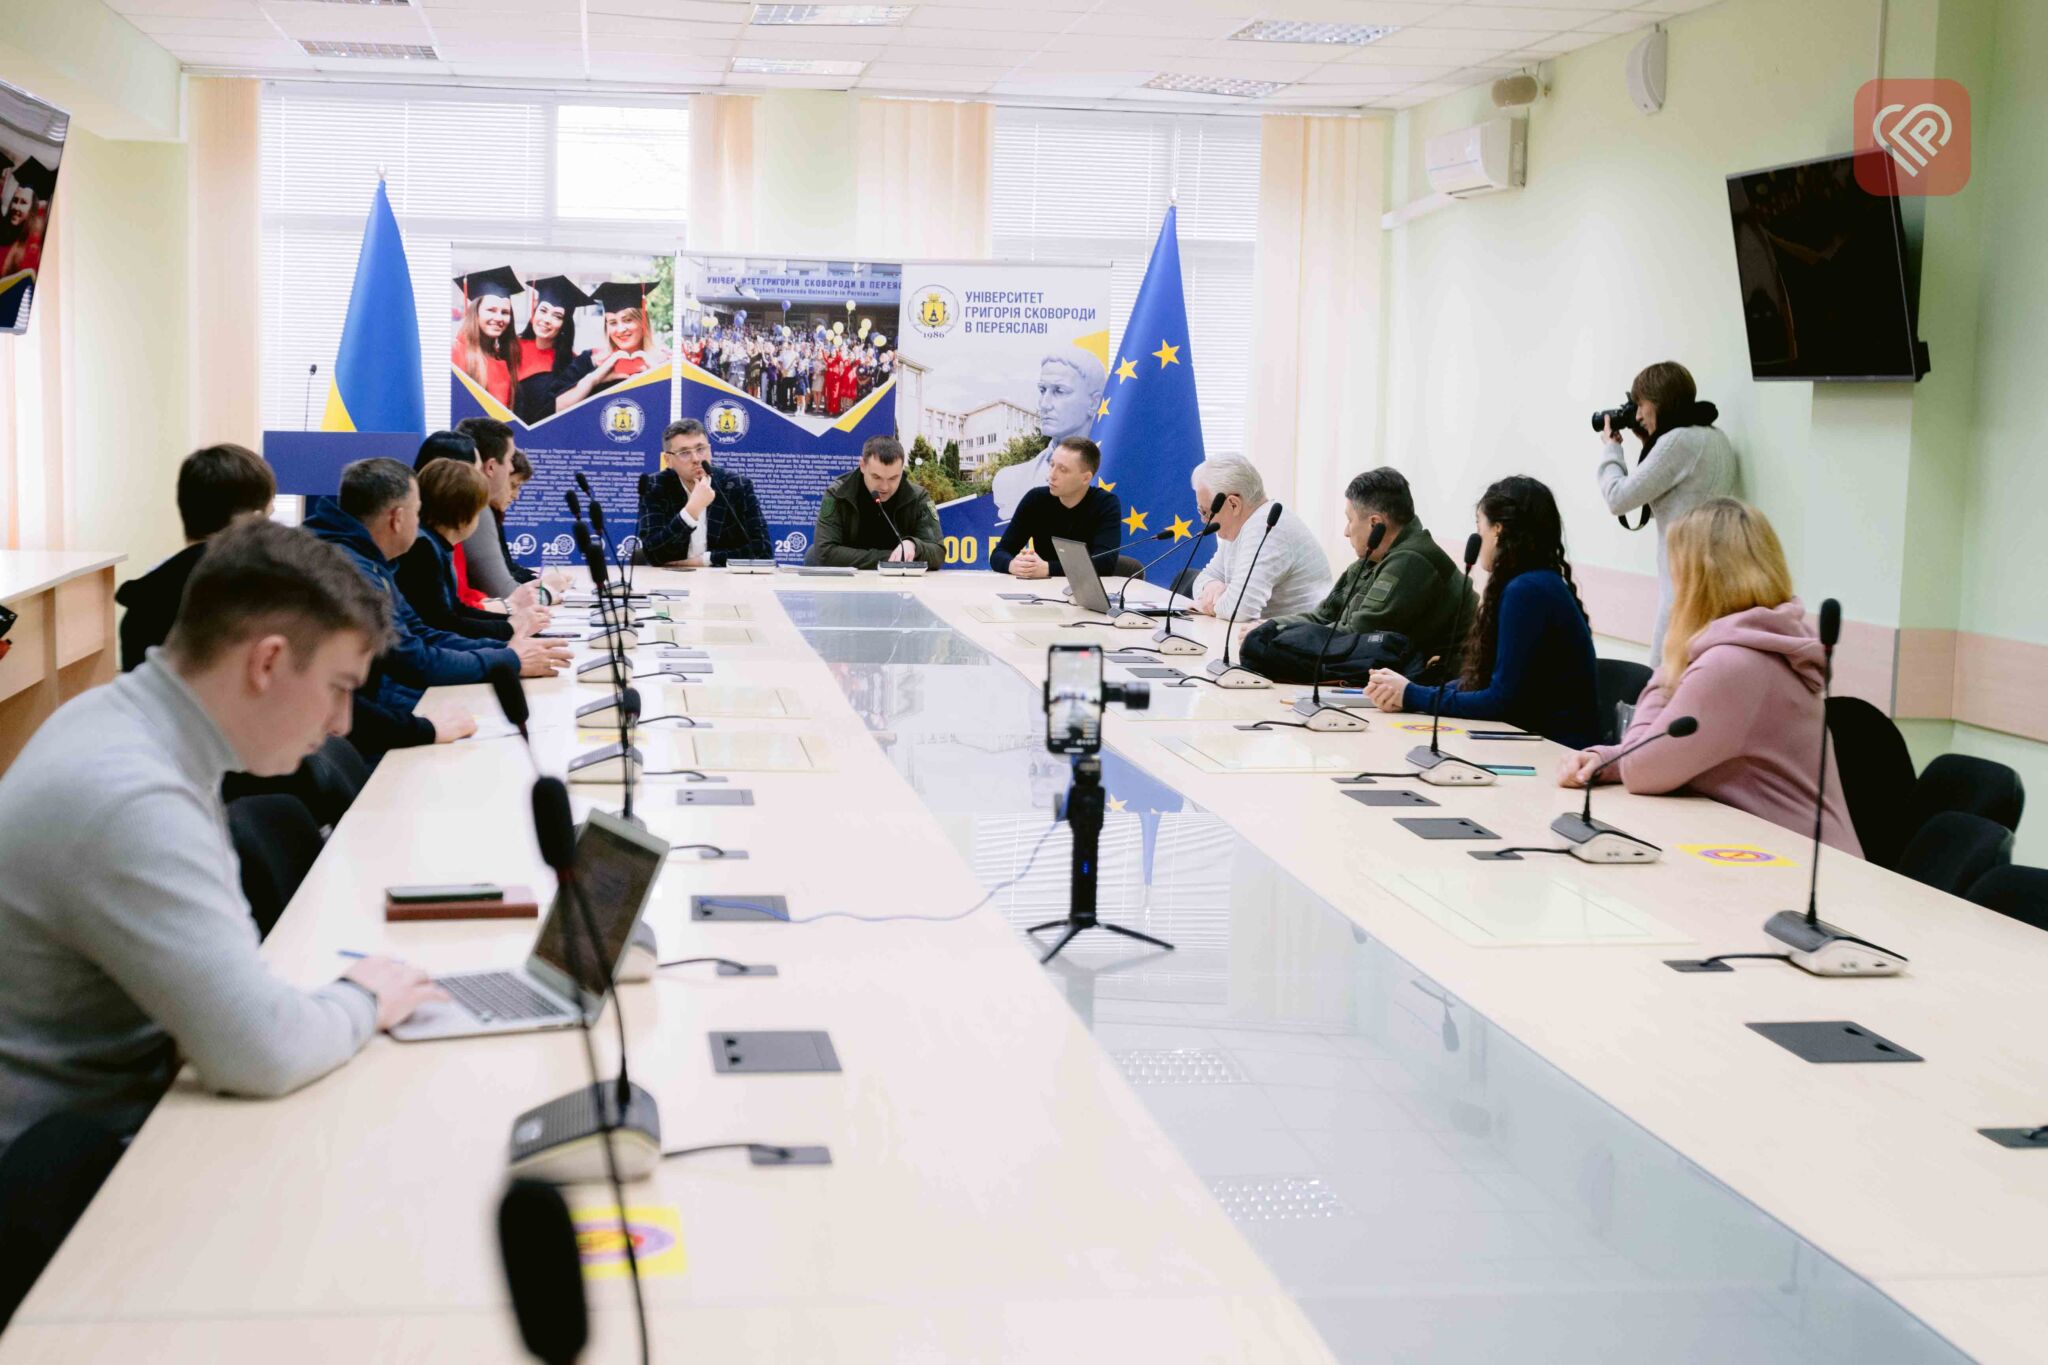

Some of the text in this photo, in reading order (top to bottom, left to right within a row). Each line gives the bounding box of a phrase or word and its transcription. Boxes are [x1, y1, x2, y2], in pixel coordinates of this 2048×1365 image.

[763, 277, 800, 286] ГРИГОРІЯ
[804, 279, 857, 289] СКОВОРОДИ
[965, 291, 1044, 304] УНІВЕРСИТЕТ
[965, 306, 1096, 321] ГРИГОРІЯ СКОВОРОДИ
[965, 322, 1048, 334] В ПЕРЕЯСЛАВІ
[923, 331, 945, 339] 1986
[542, 541, 558, 556] 29
[774, 539, 791, 553] 29
